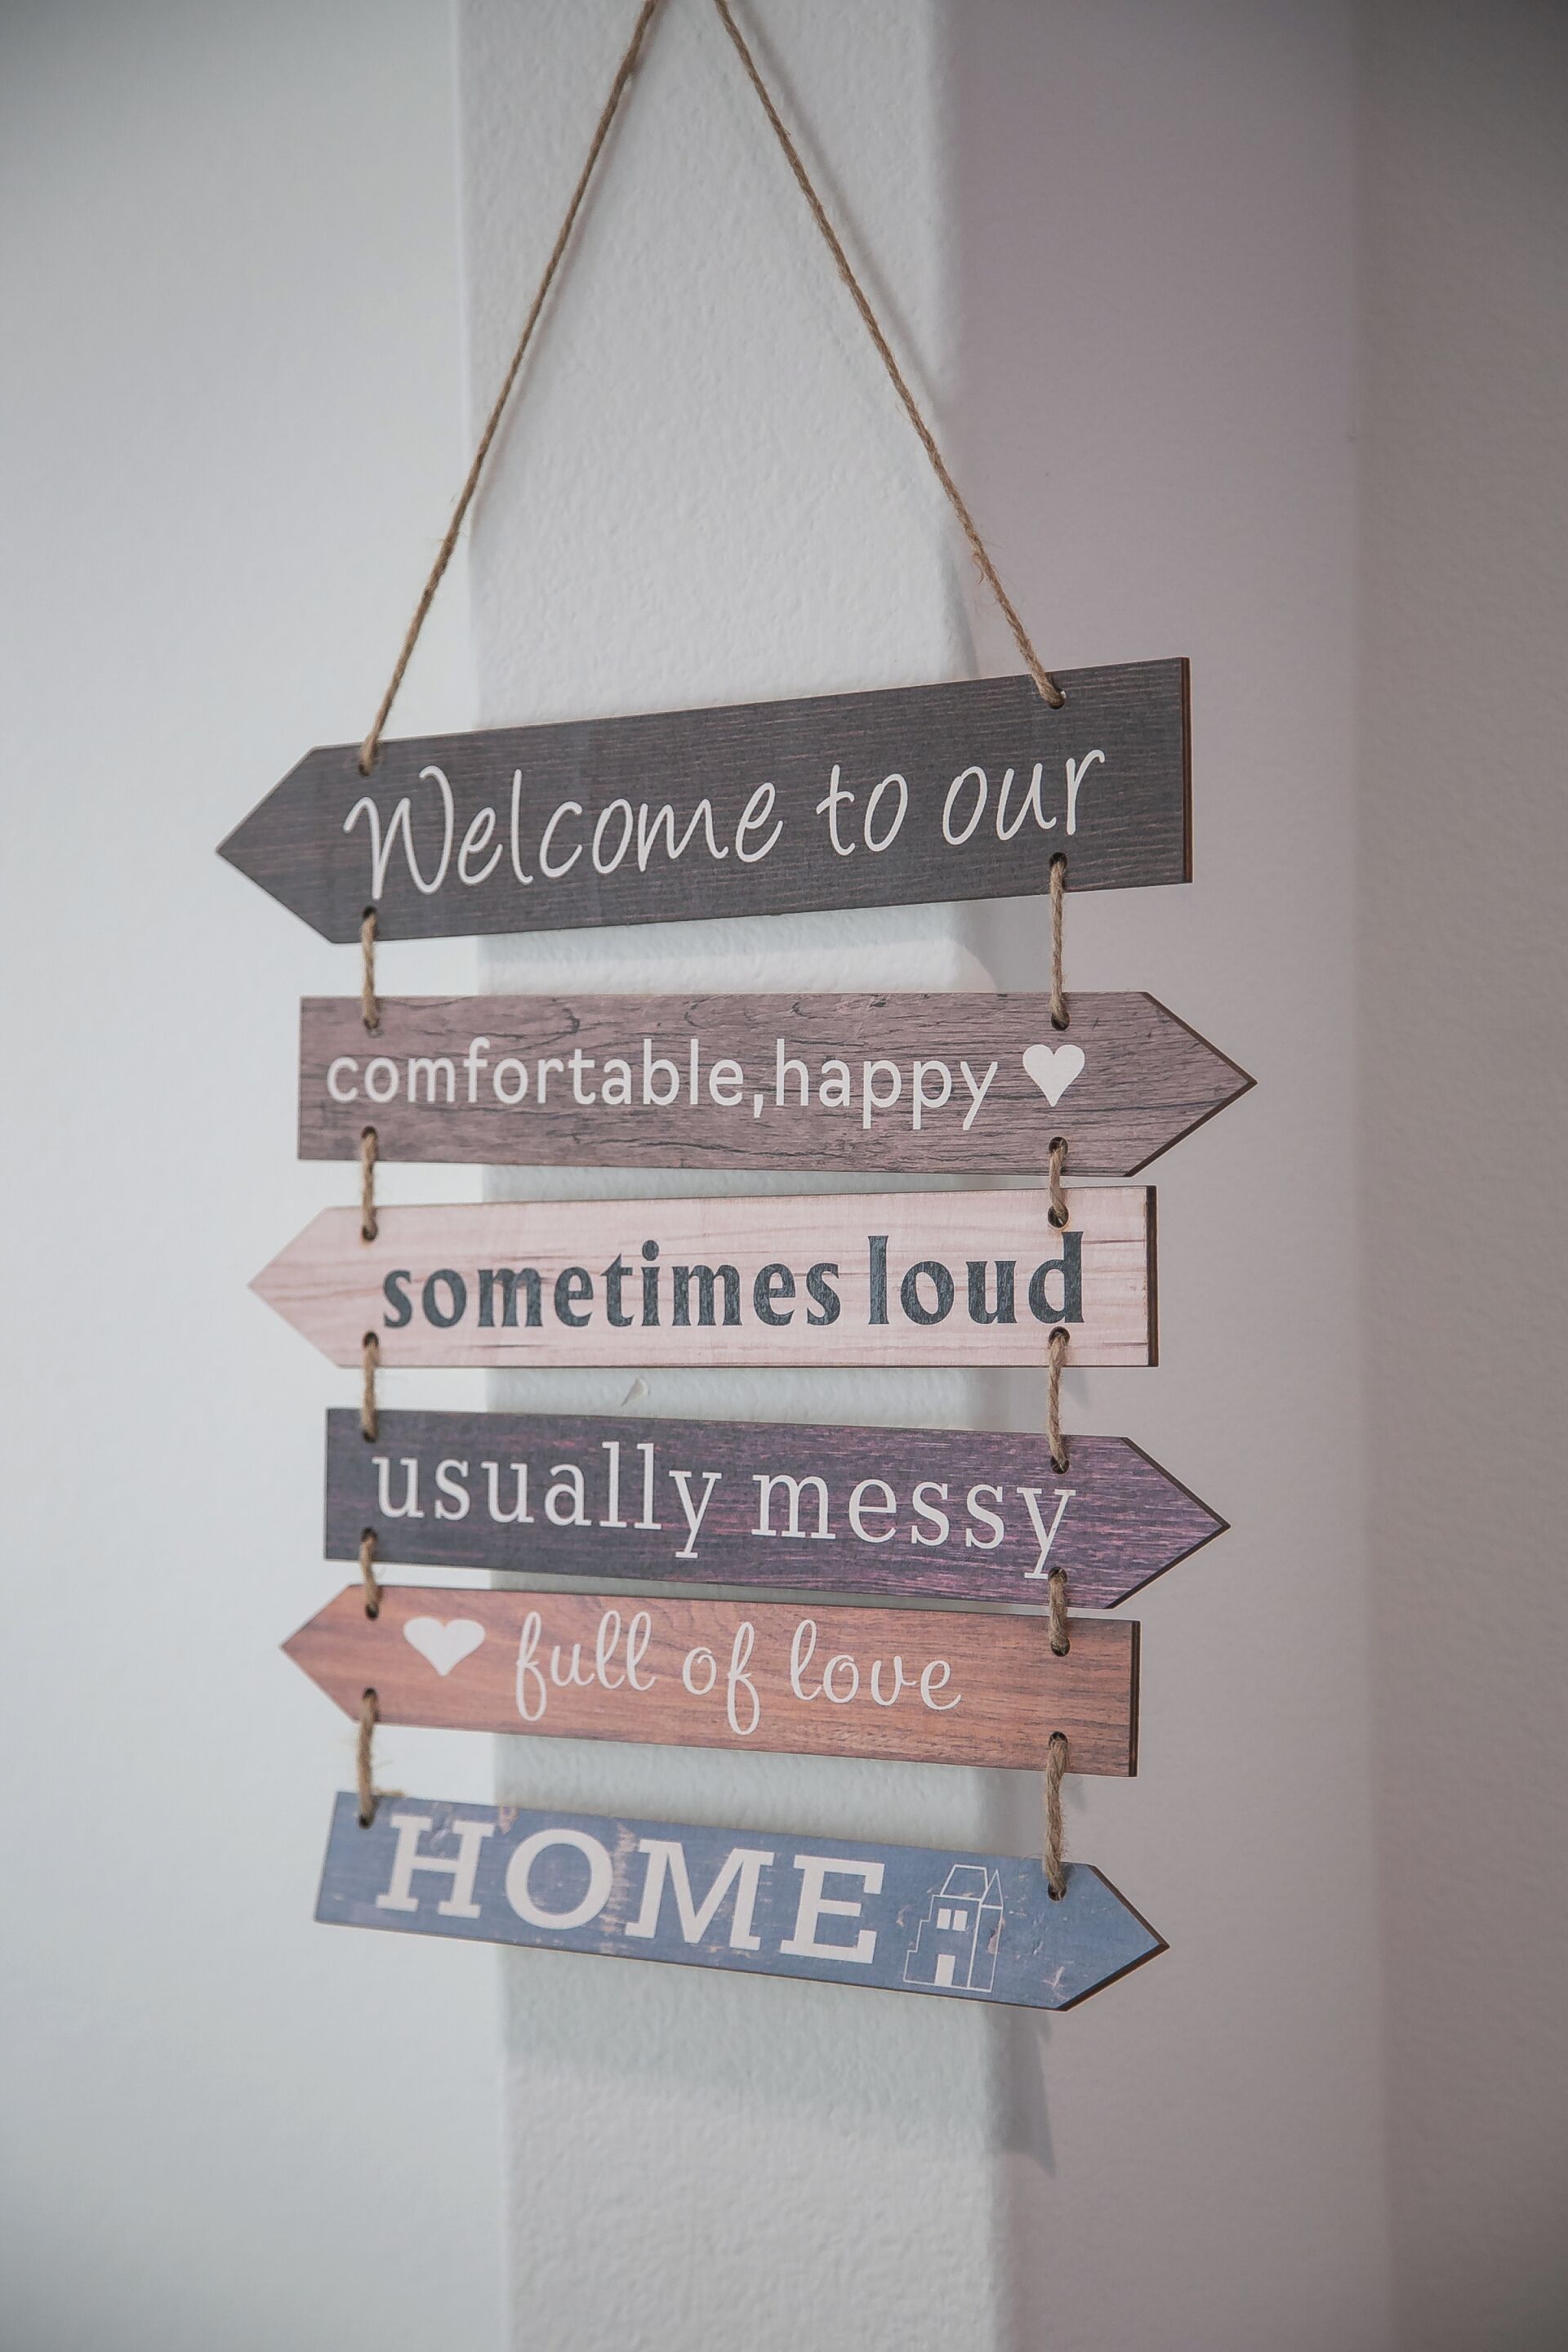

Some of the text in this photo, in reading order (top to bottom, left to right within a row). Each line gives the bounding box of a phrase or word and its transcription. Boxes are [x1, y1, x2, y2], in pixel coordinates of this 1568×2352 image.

[343, 748, 1107, 901] Welcome to our
[382, 1230, 1085, 1330] sometimes loud
[372, 1441, 1077, 1579] usually messy
[515, 1609, 963, 1736] full of love
[375, 1814, 886, 1965] HOME
